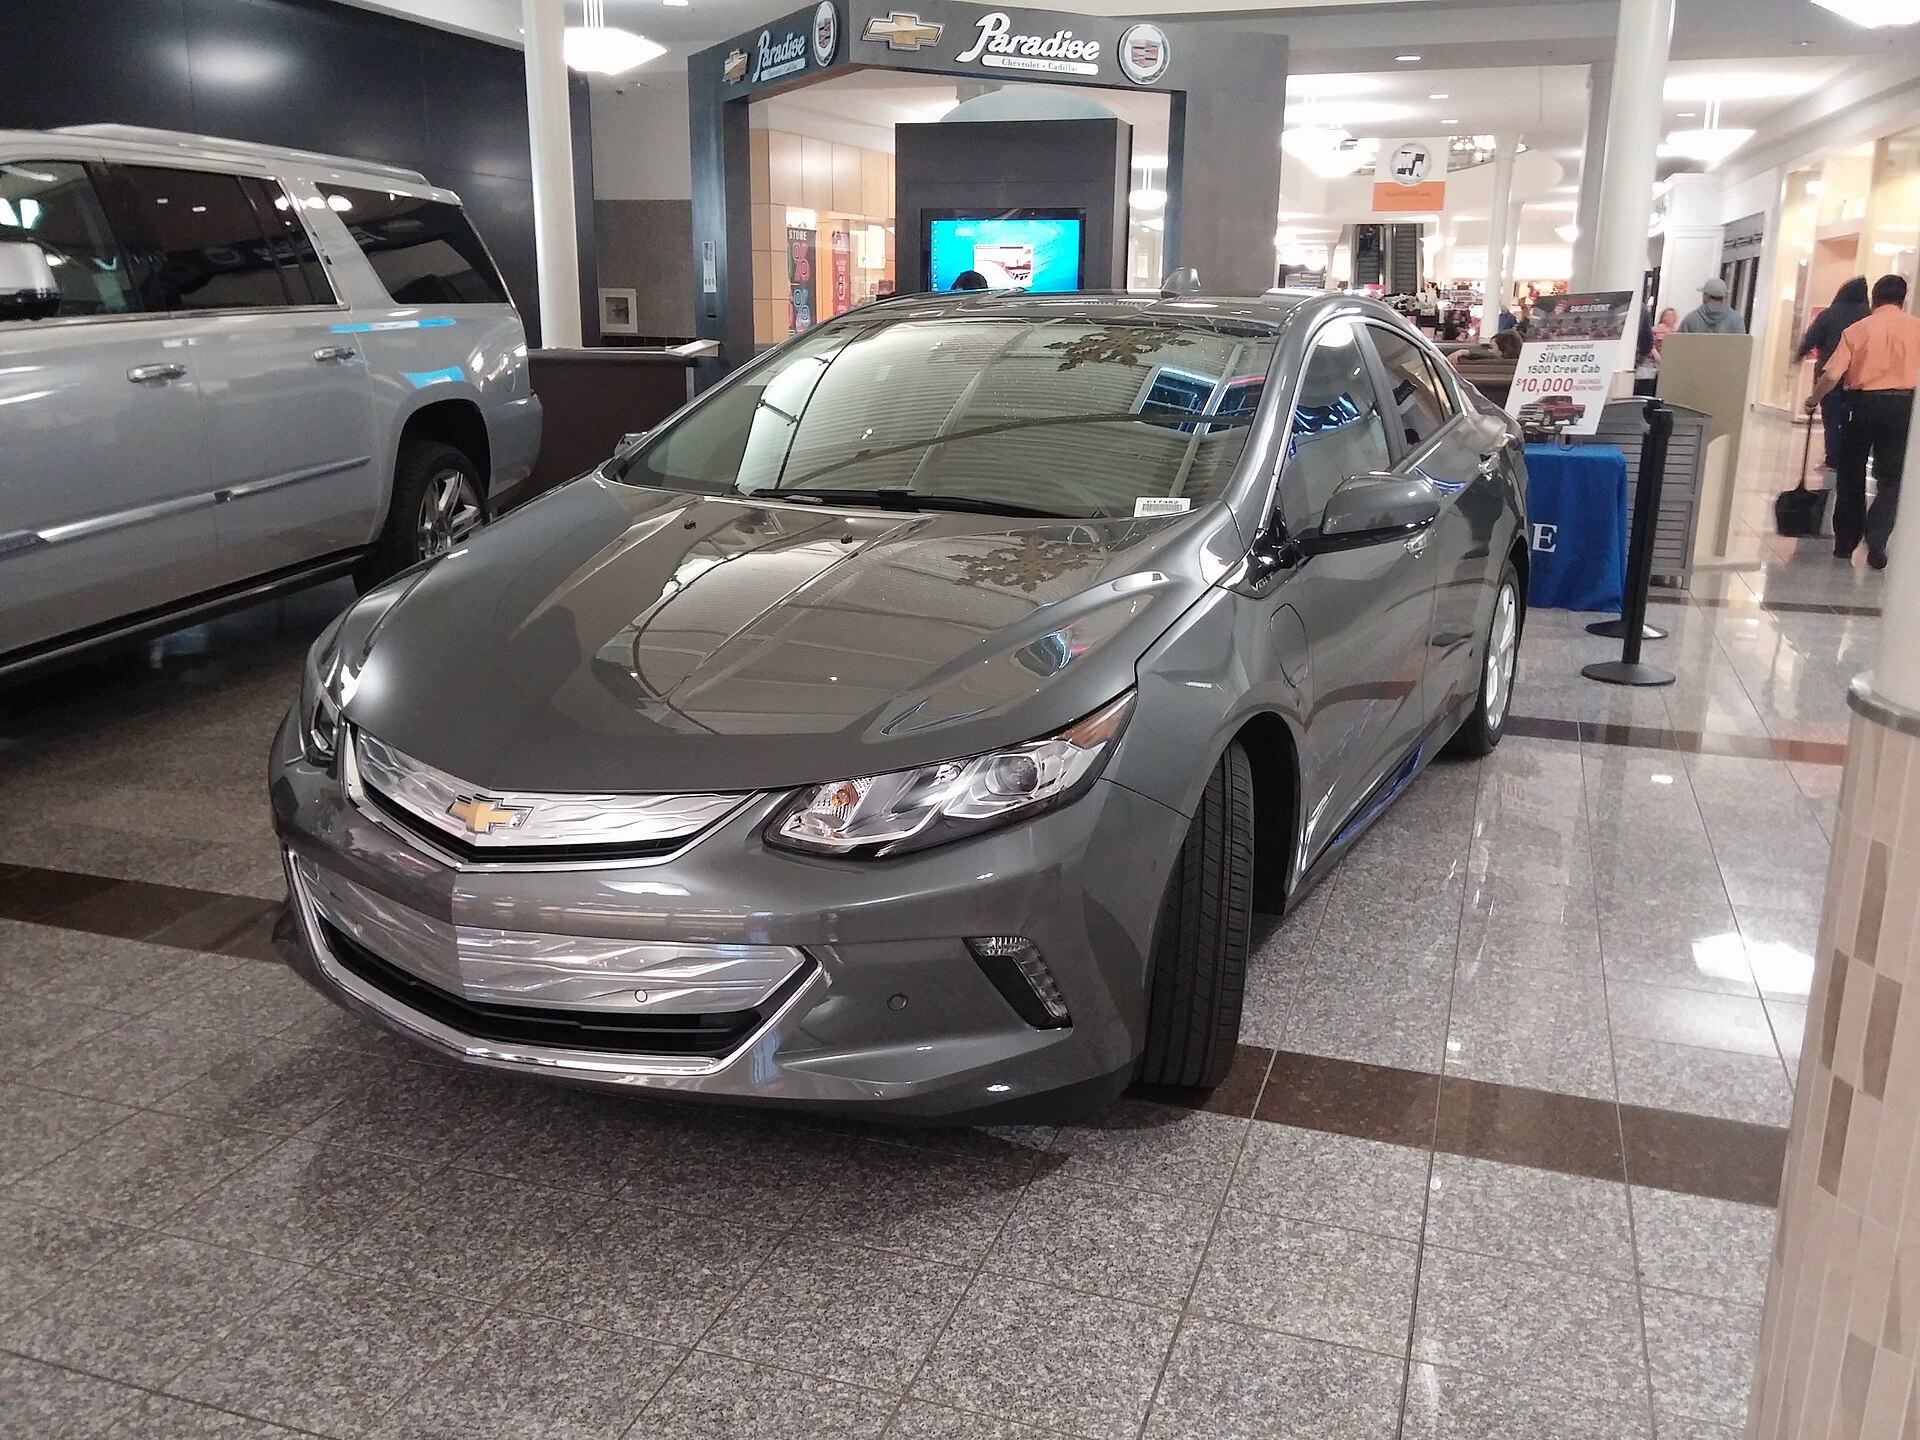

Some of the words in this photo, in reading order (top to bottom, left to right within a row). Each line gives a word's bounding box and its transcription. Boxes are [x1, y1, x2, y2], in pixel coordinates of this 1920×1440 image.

[955, 12, 1100, 62] Paradise
[751, 30, 805, 83] Paradise
[1001, 57, 1040, 69] Chevrolet
[788, 229, 808, 241] STORE
[1538, 351, 1595, 364] Silverado
[1527, 365, 1551, 374] 1500
[1553, 365, 1579, 374] Crew
[1581, 364, 1601, 374] Cab
[1515, 377, 1573, 395] $10,000
